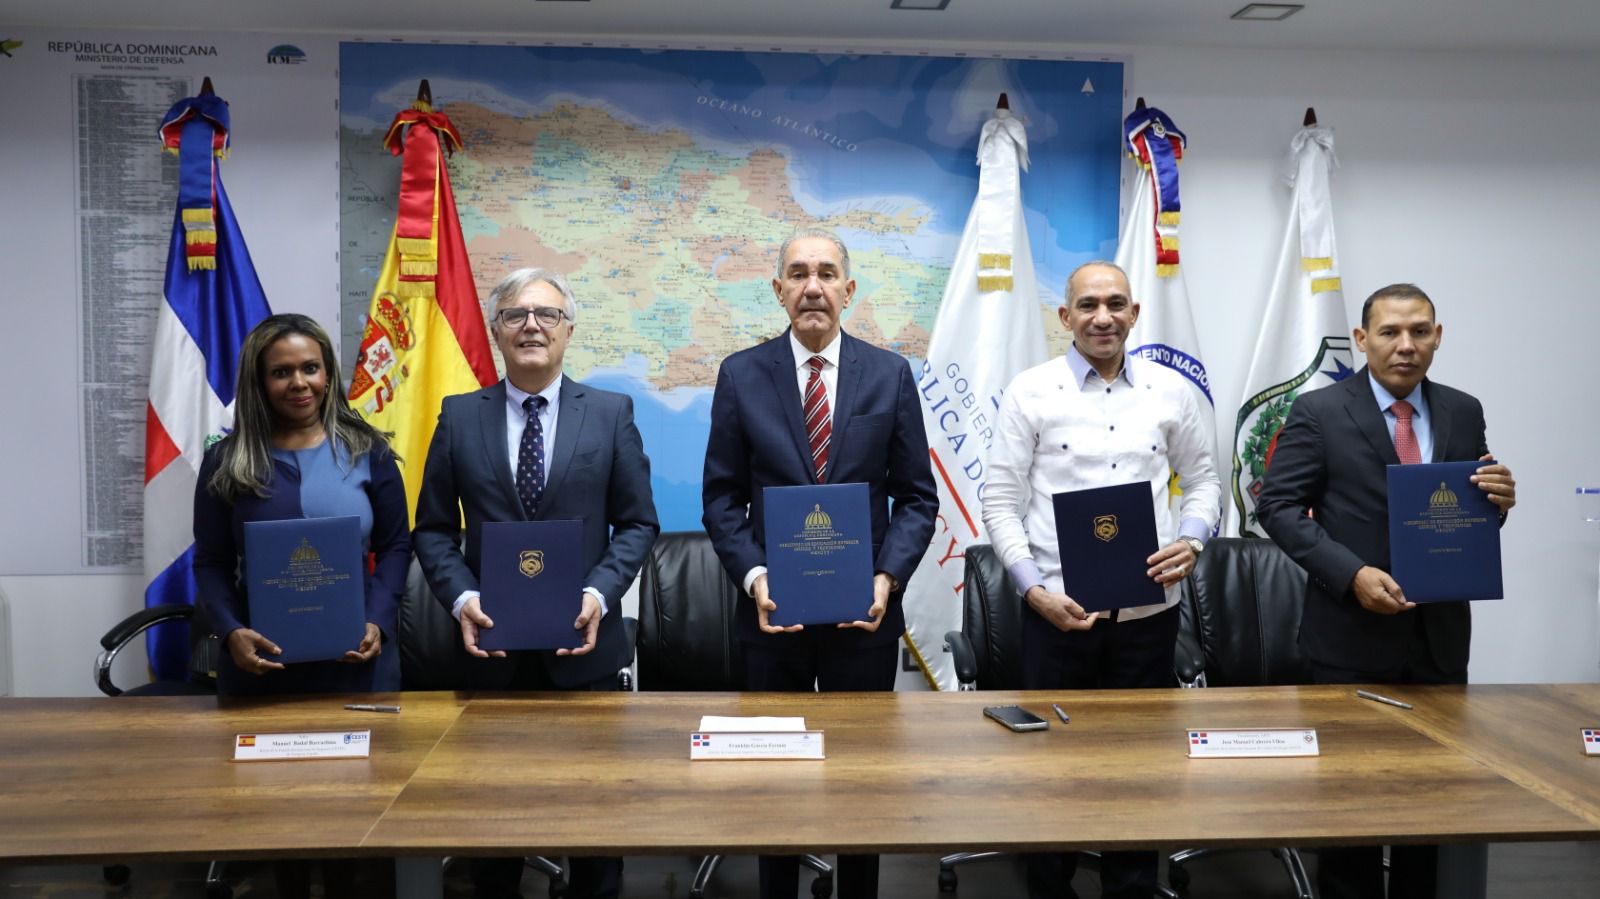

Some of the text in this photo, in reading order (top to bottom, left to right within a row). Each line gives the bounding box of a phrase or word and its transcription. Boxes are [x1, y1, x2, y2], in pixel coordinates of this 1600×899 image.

[48, 41, 218, 56] REPÚBLICA DOMINICANA
[75, 54, 184, 64] MINISTERIO DE DEFENSA
[946, 362, 993, 450] GOBIER
